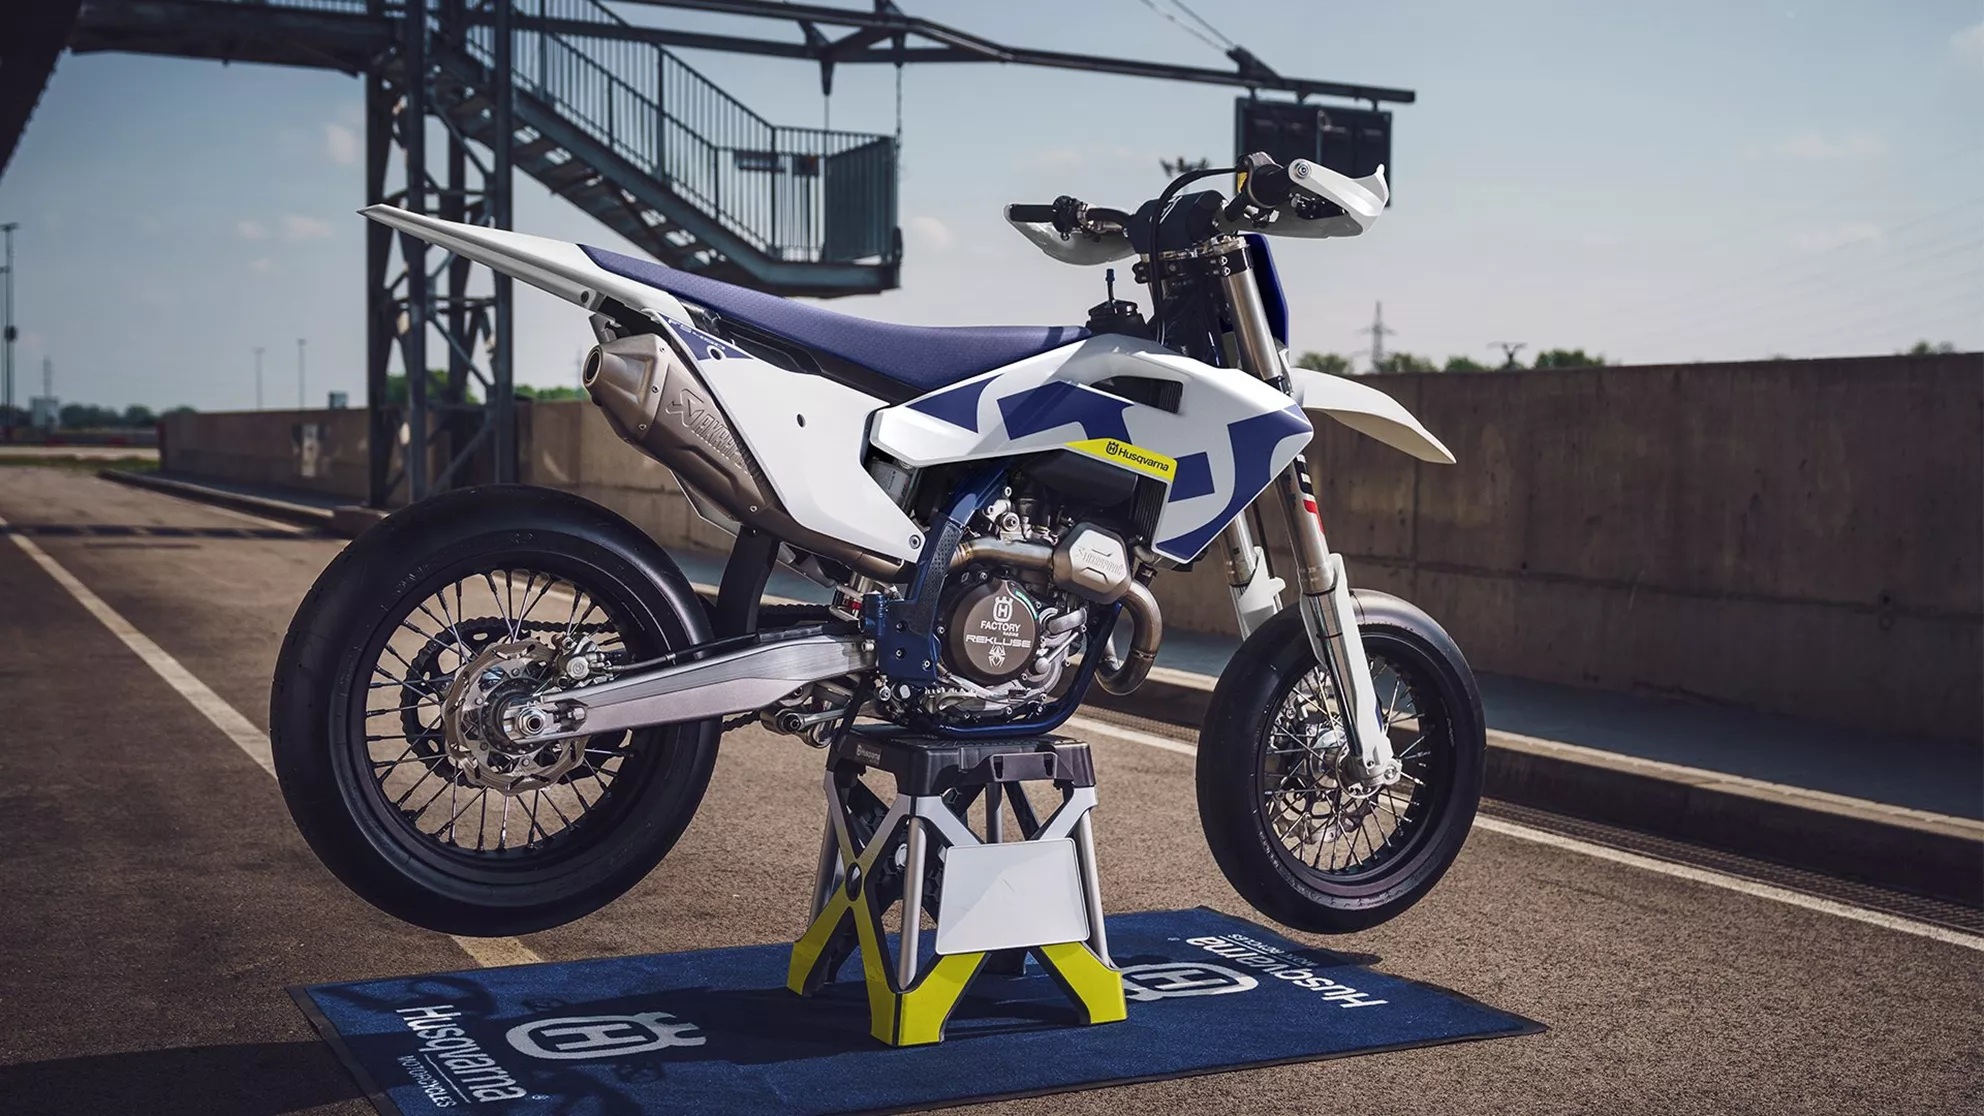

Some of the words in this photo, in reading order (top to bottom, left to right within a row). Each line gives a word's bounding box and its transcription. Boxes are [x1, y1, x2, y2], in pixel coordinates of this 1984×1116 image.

[1117, 447, 1170, 472] Husqvarna
[965, 634, 1031, 649] REKLUSE
[980, 620, 1021, 632] FACTORY
[1185, 936, 1389, 1009] Husqvarna
[396, 1004, 528, 1103] Husqvarna
[397, 1054, 458, 1108] MOTORCYCLES
